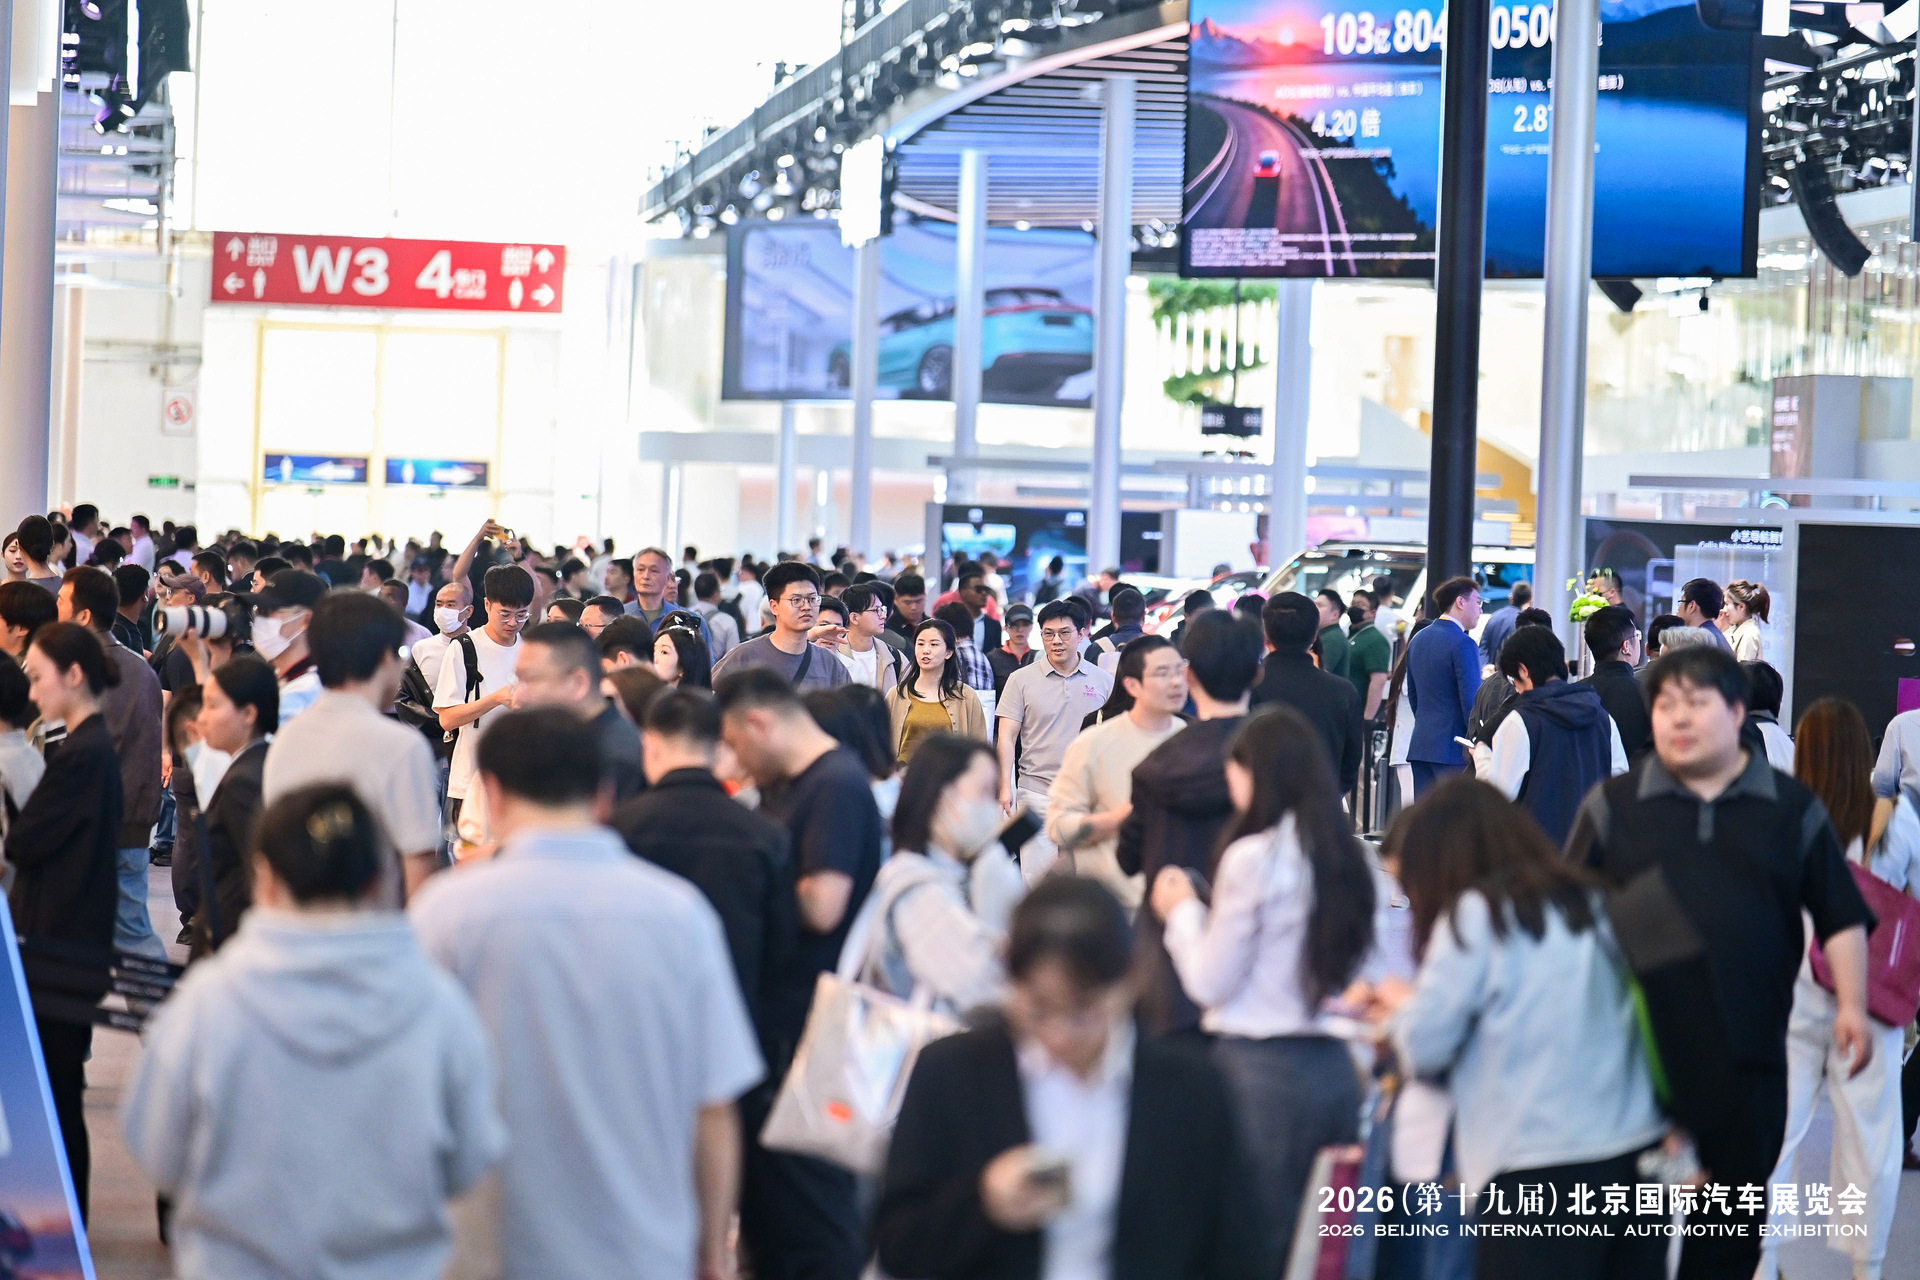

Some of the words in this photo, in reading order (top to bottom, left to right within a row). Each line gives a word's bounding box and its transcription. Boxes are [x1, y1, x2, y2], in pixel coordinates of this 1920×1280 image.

[1311, 108, 1357, 138] 4.20
[1360, 106, 1381, 138] 倍
[1513, 104, 1553, 132] 2.8
[292, 244, 389, 297] W3
